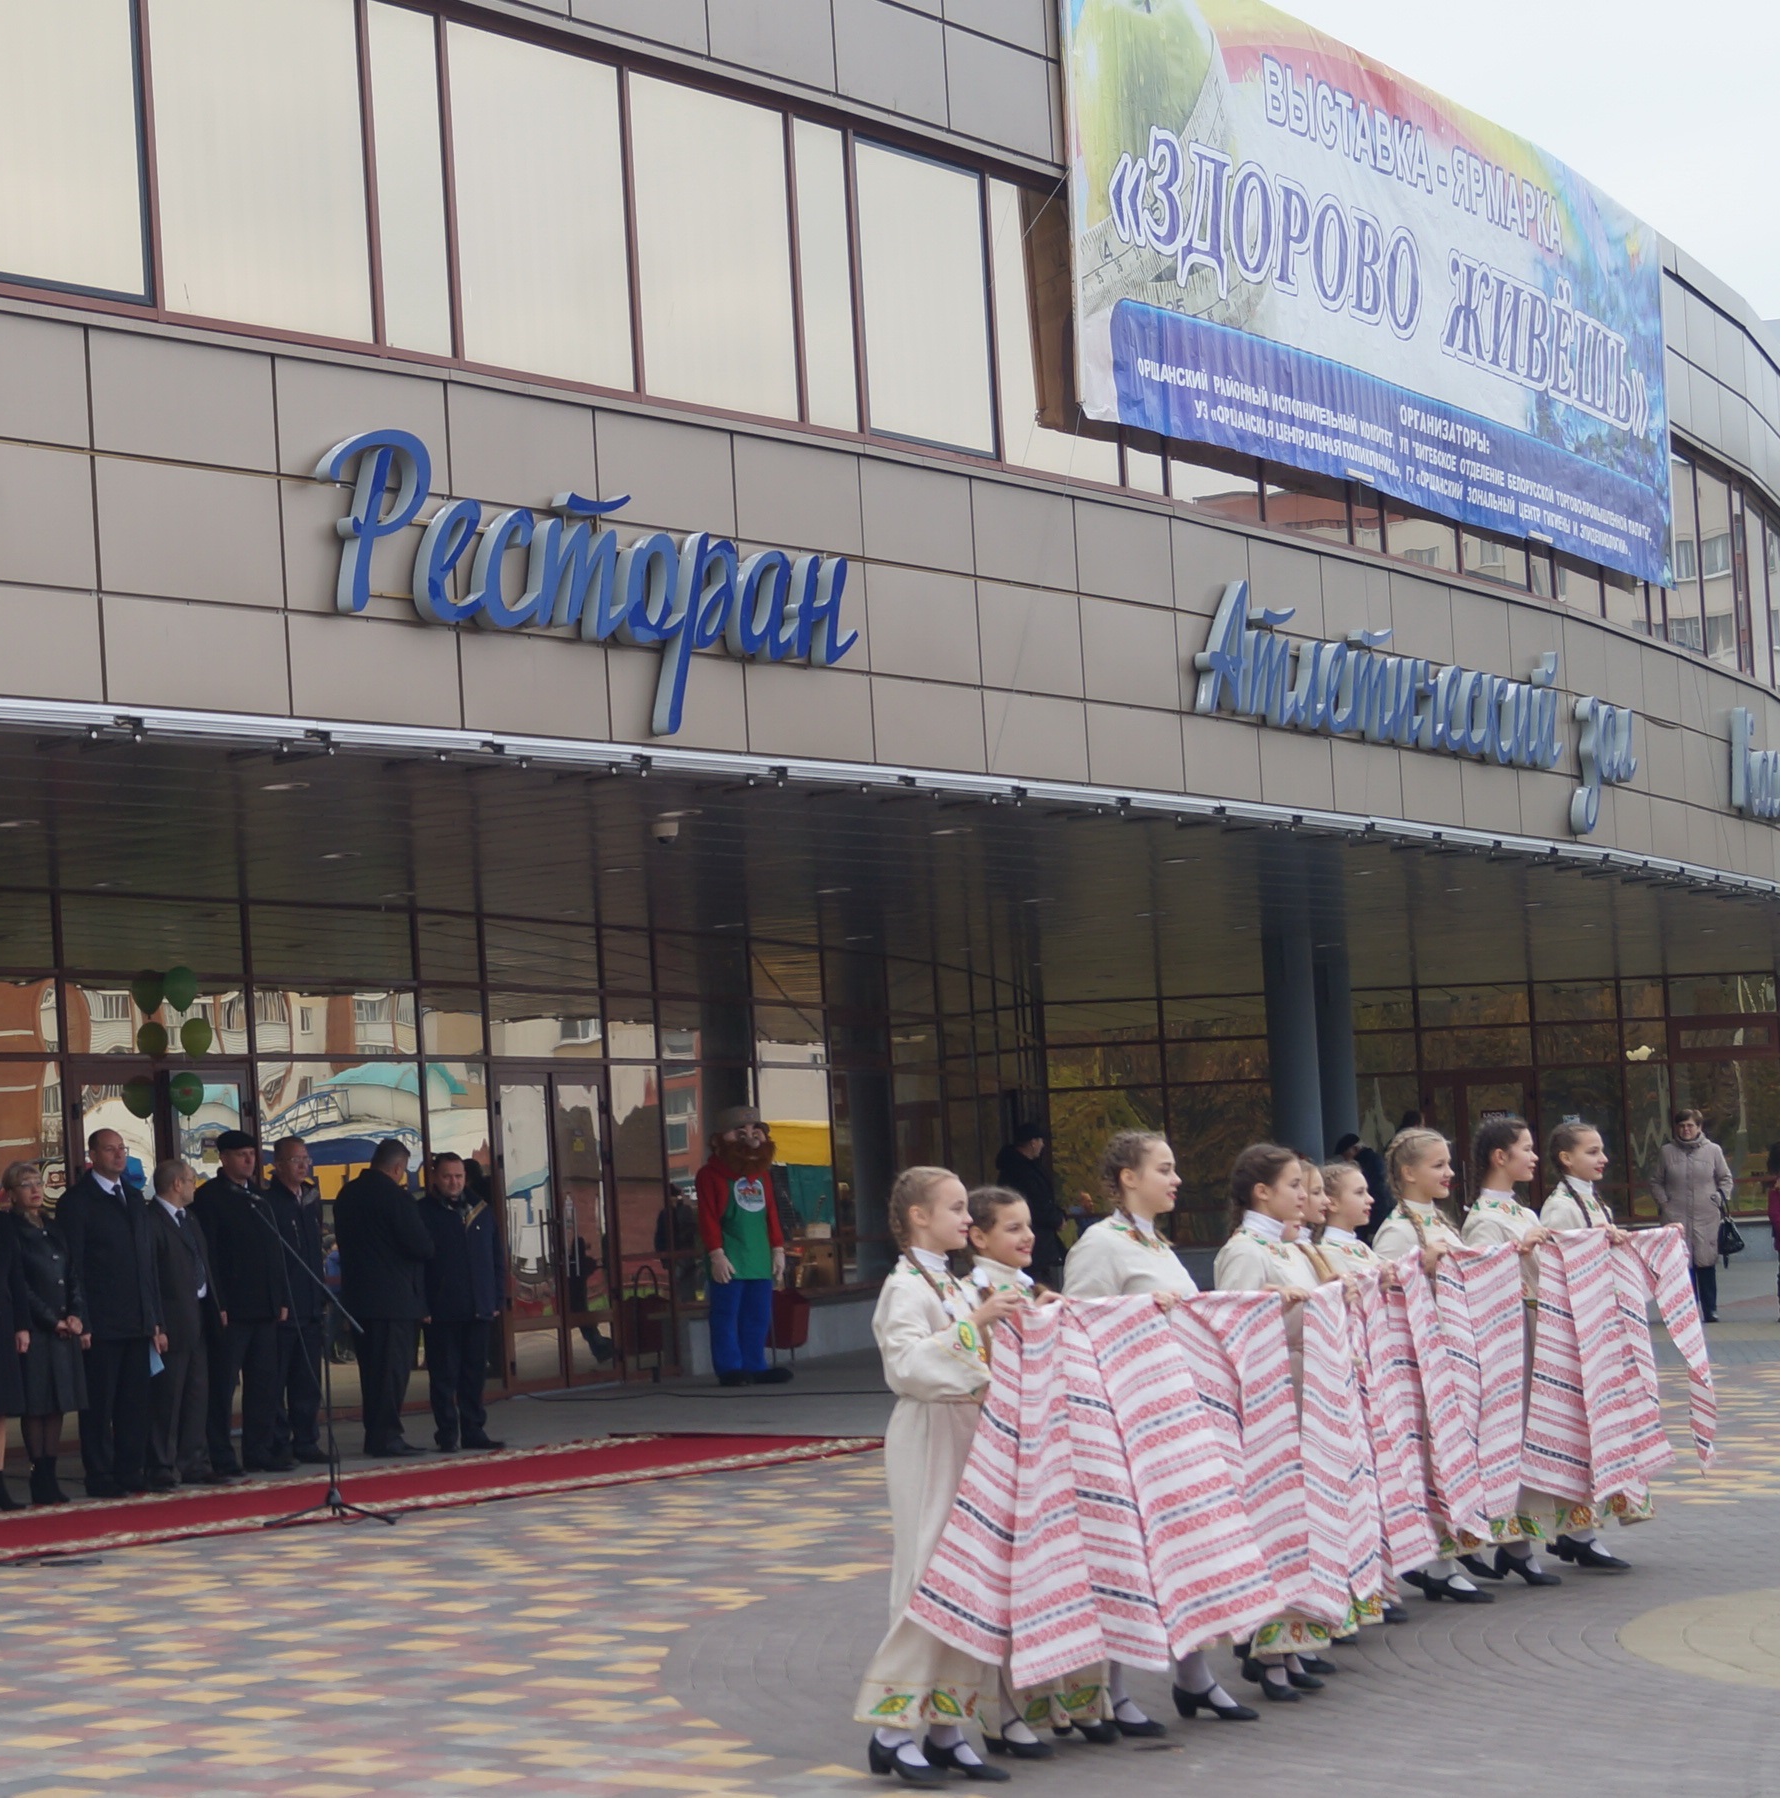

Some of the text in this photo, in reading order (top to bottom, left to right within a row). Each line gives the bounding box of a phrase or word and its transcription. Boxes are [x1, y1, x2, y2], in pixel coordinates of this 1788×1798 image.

[1263, 53, 1432, 194] ВЫСТАВКА
[1452, 145, 1564, 257] ЯРМАРКА
[1110, 126, 1650, 439] «ЗДОРОВО ЖИВЁШЬ»
[1137, 357, 1209, 392] ОРШАНСКИЙ
[1213, 375, 1269, 408] РАЙОННЫЙ
[1272, 393, 1358, 435] ИСПОЛНИТЕЛЬНЫЙ
[1459, 458, 1505, 487] ОТДЕЛЕНИЕ
[1194, 400, 1208, 420] УЗ
[1211, 404, 1273, 438] «ОРШАНСКАЯ
[1275, 422, 1342, 457] ЦЕНТРАЛЬНАЯ
[1467, 486, 1515, 515] ЗОНАЛЬНЫЙ
[1518, 500, 1541, 522] ЦЕНТР
[1399, 404, 1490, 454] ОРГАНИЗАТОРЫ:
[315, 429, 858, 736] Ресторан
[1195, 580, 1563, 768] Атлетический
